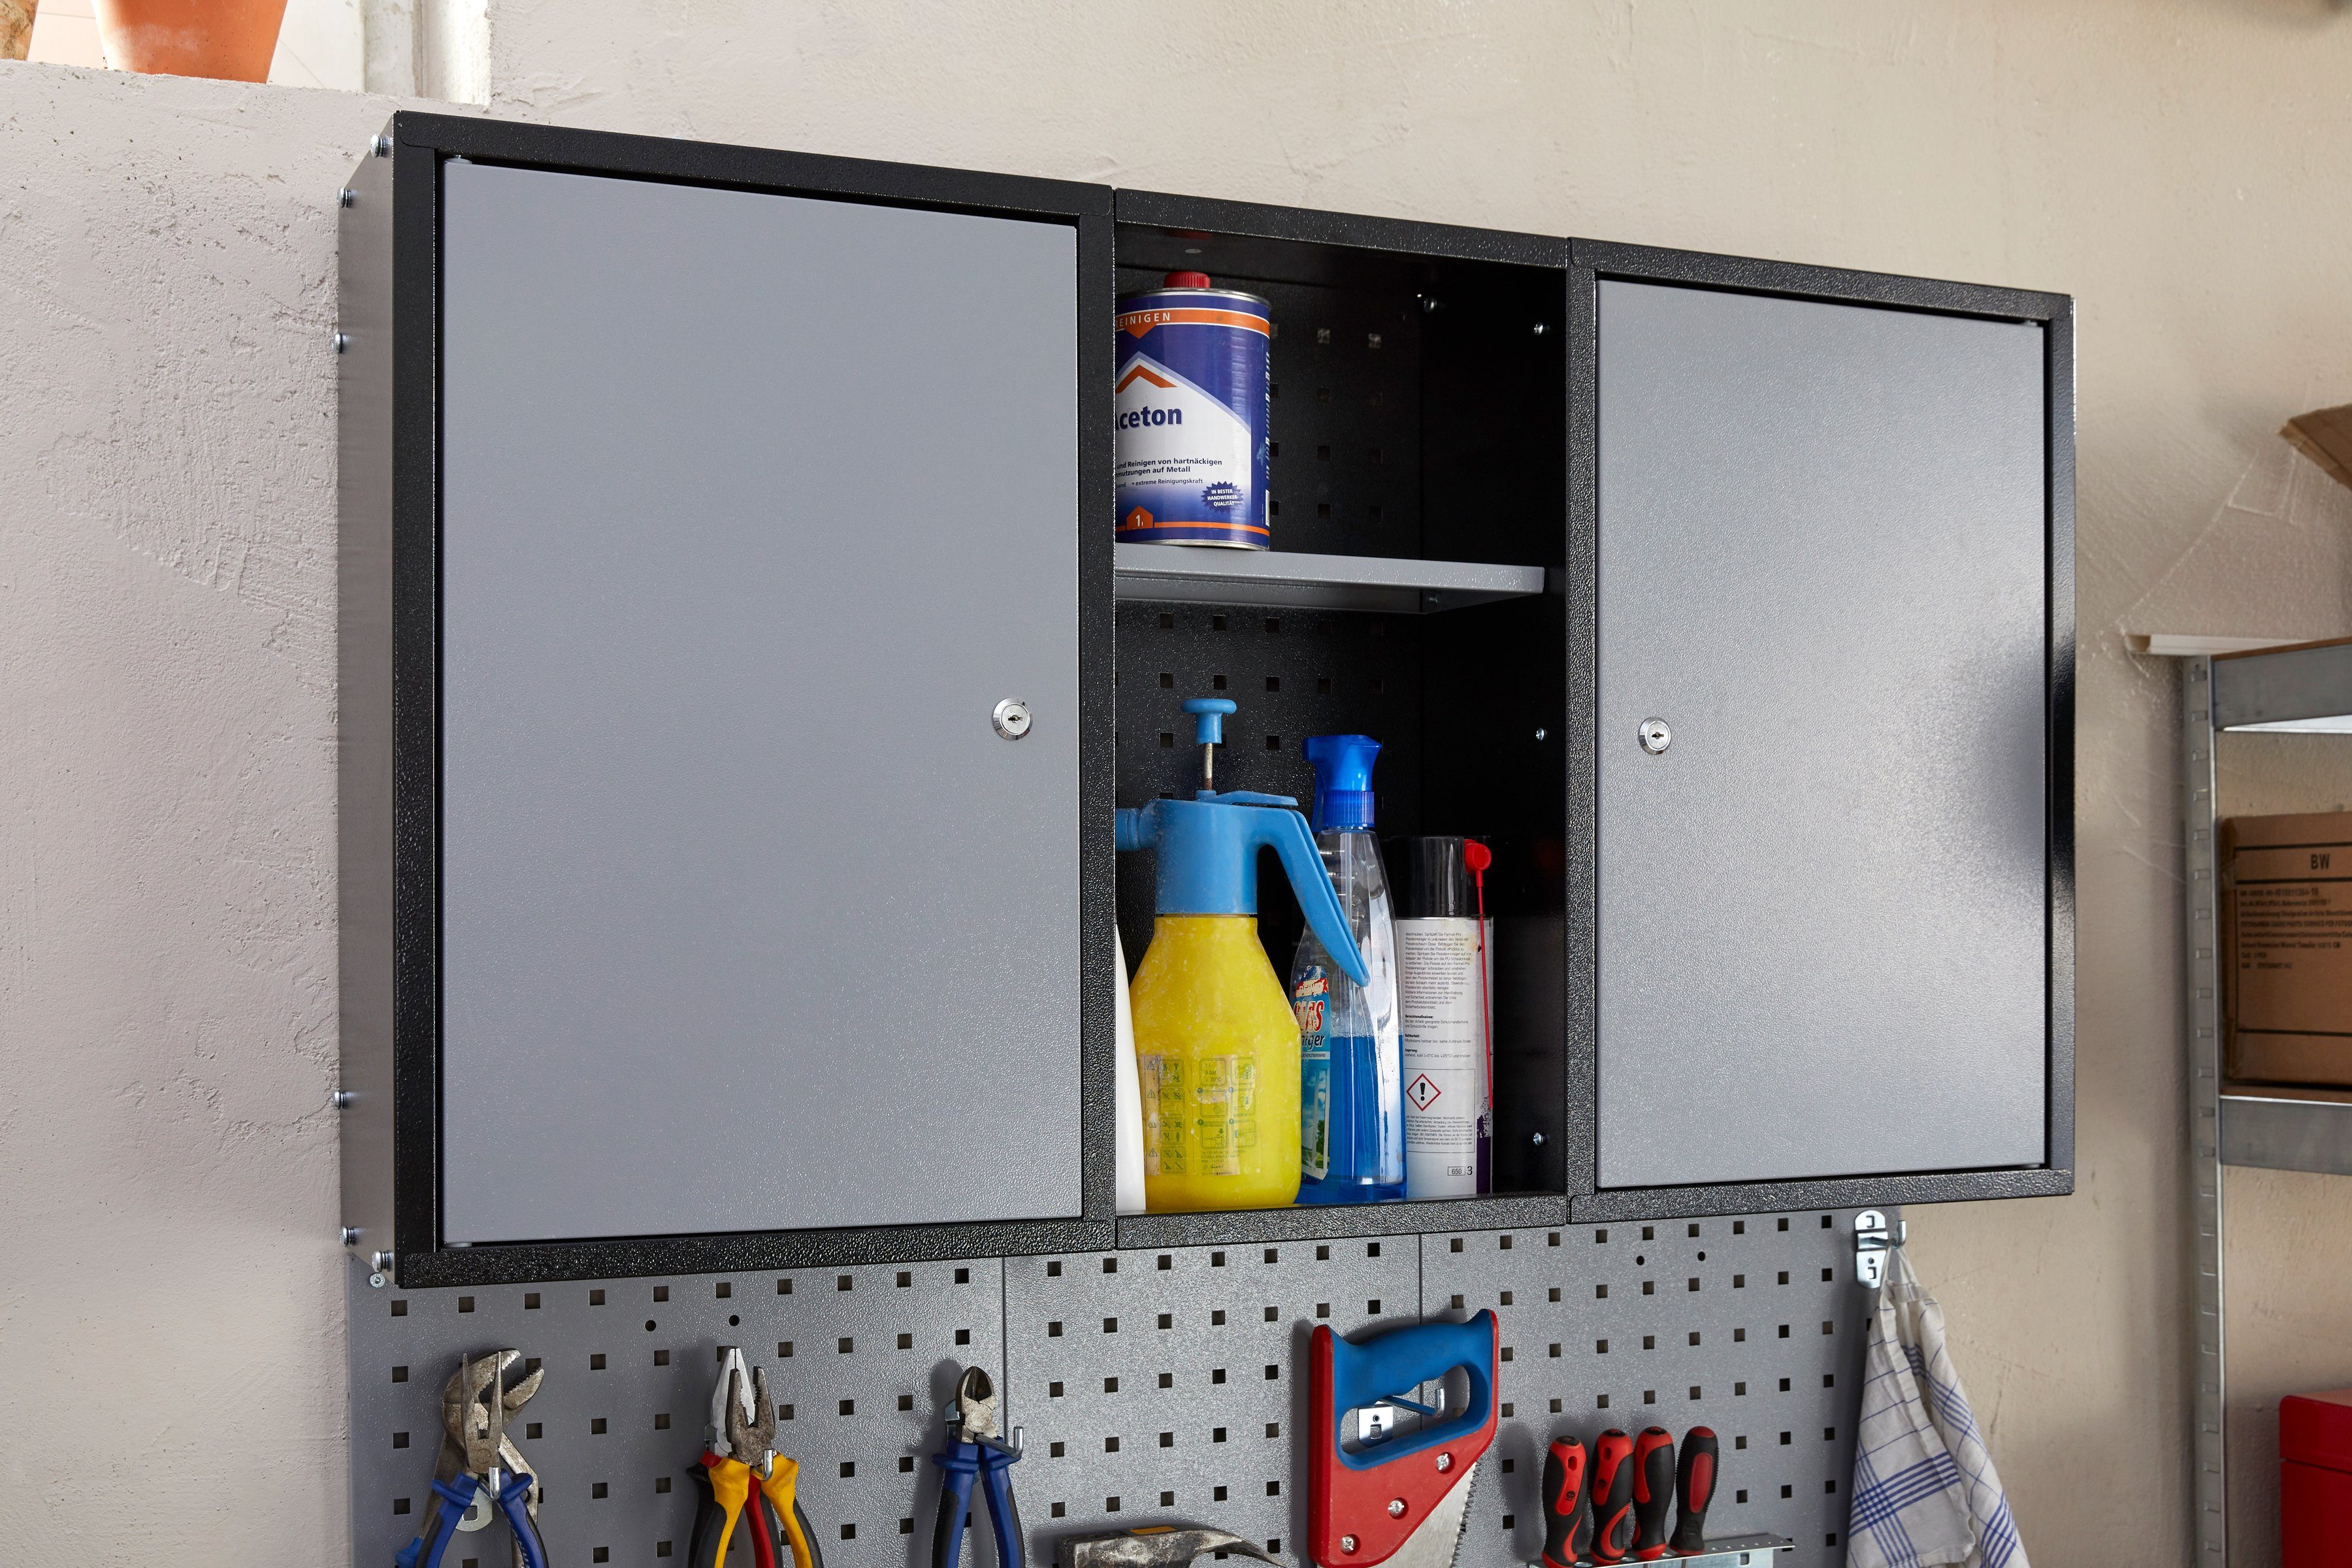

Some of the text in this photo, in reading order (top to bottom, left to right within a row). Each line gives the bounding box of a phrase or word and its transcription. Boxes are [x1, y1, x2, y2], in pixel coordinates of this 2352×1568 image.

[1174, 458, 1222, 466] hartnäckigen
[2310, 853, 2330, 870] BW
[1467, 1166, 1473, 1175] 3
